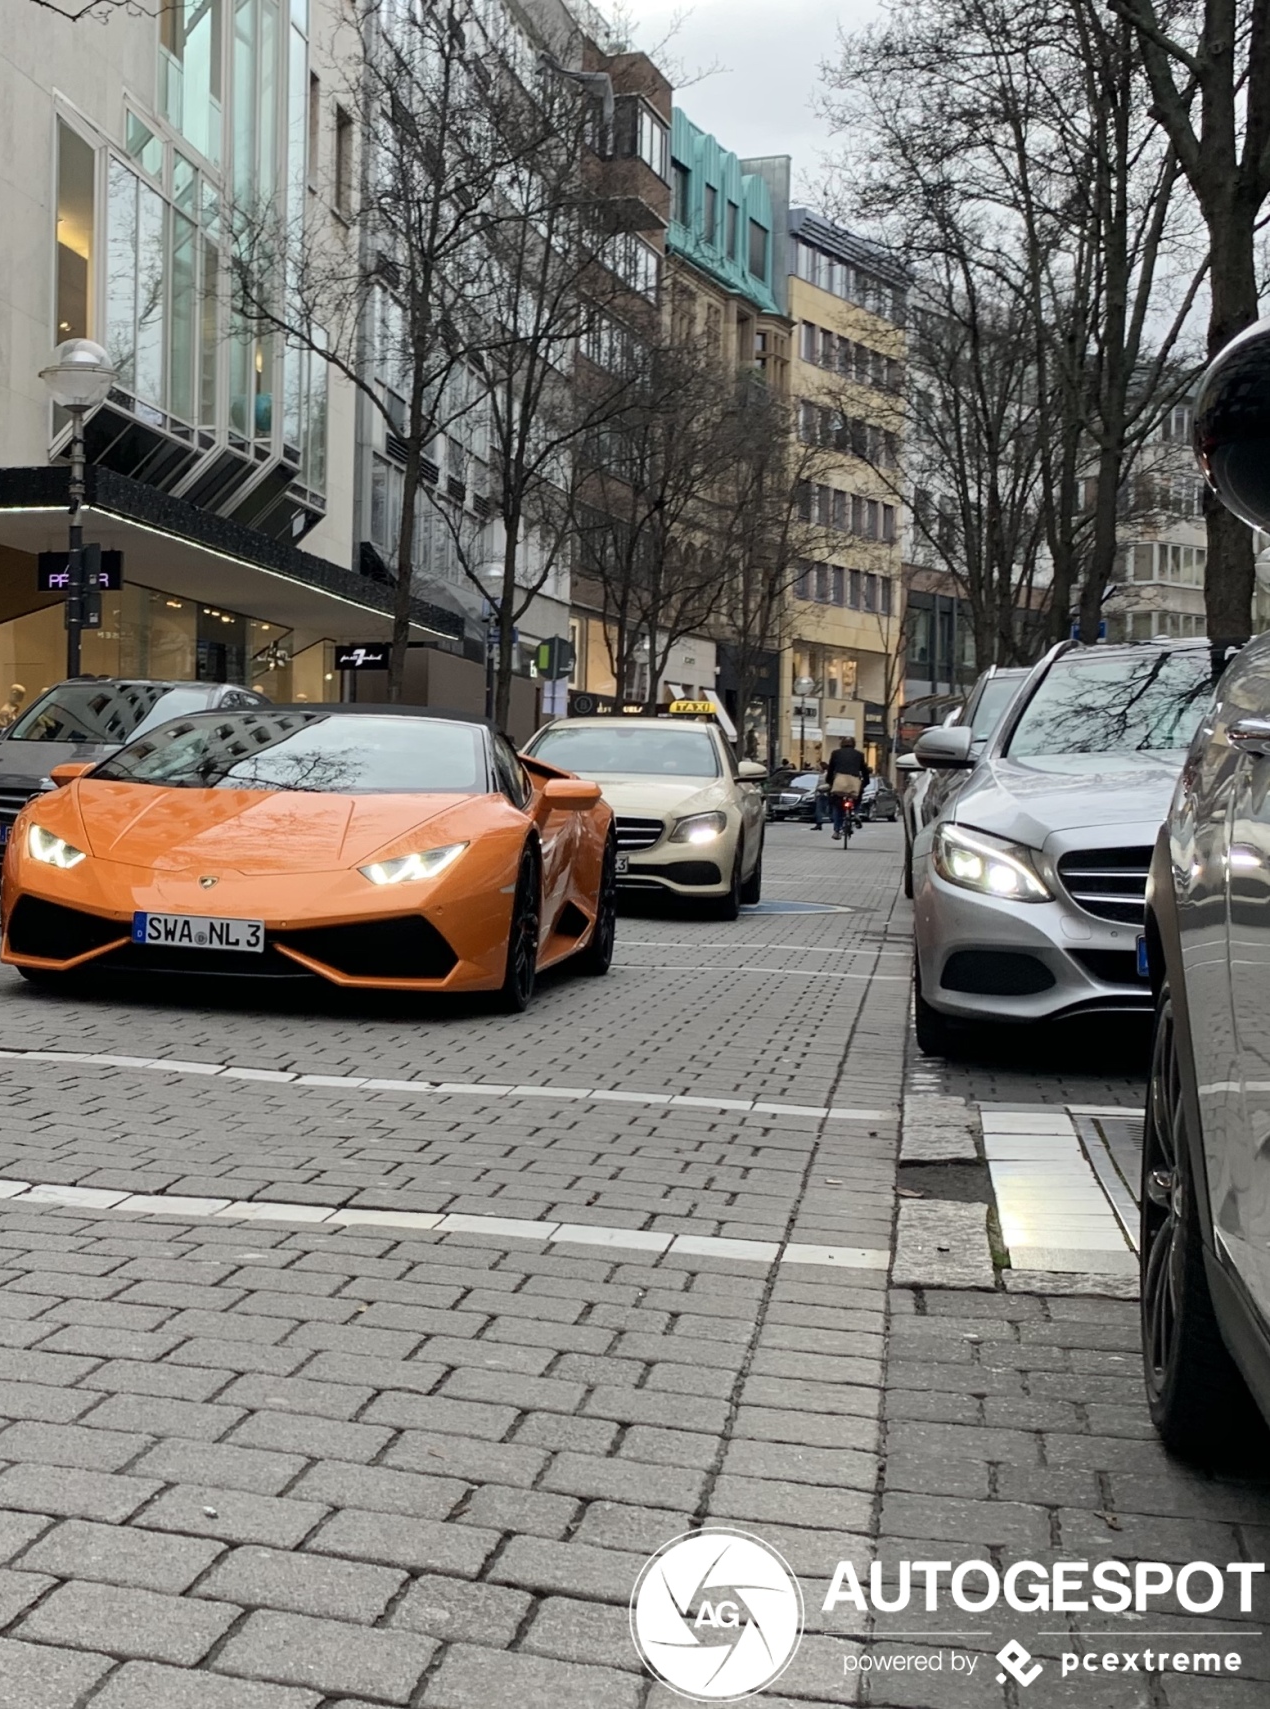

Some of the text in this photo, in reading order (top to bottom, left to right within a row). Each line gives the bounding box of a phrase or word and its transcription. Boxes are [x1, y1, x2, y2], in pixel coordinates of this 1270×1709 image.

[677, 703, 709, 711] TAXI
[148, 917, 192, 942] SWA
[209, 922, 239, 946] NL
[247, 924, 261, 947] 3
